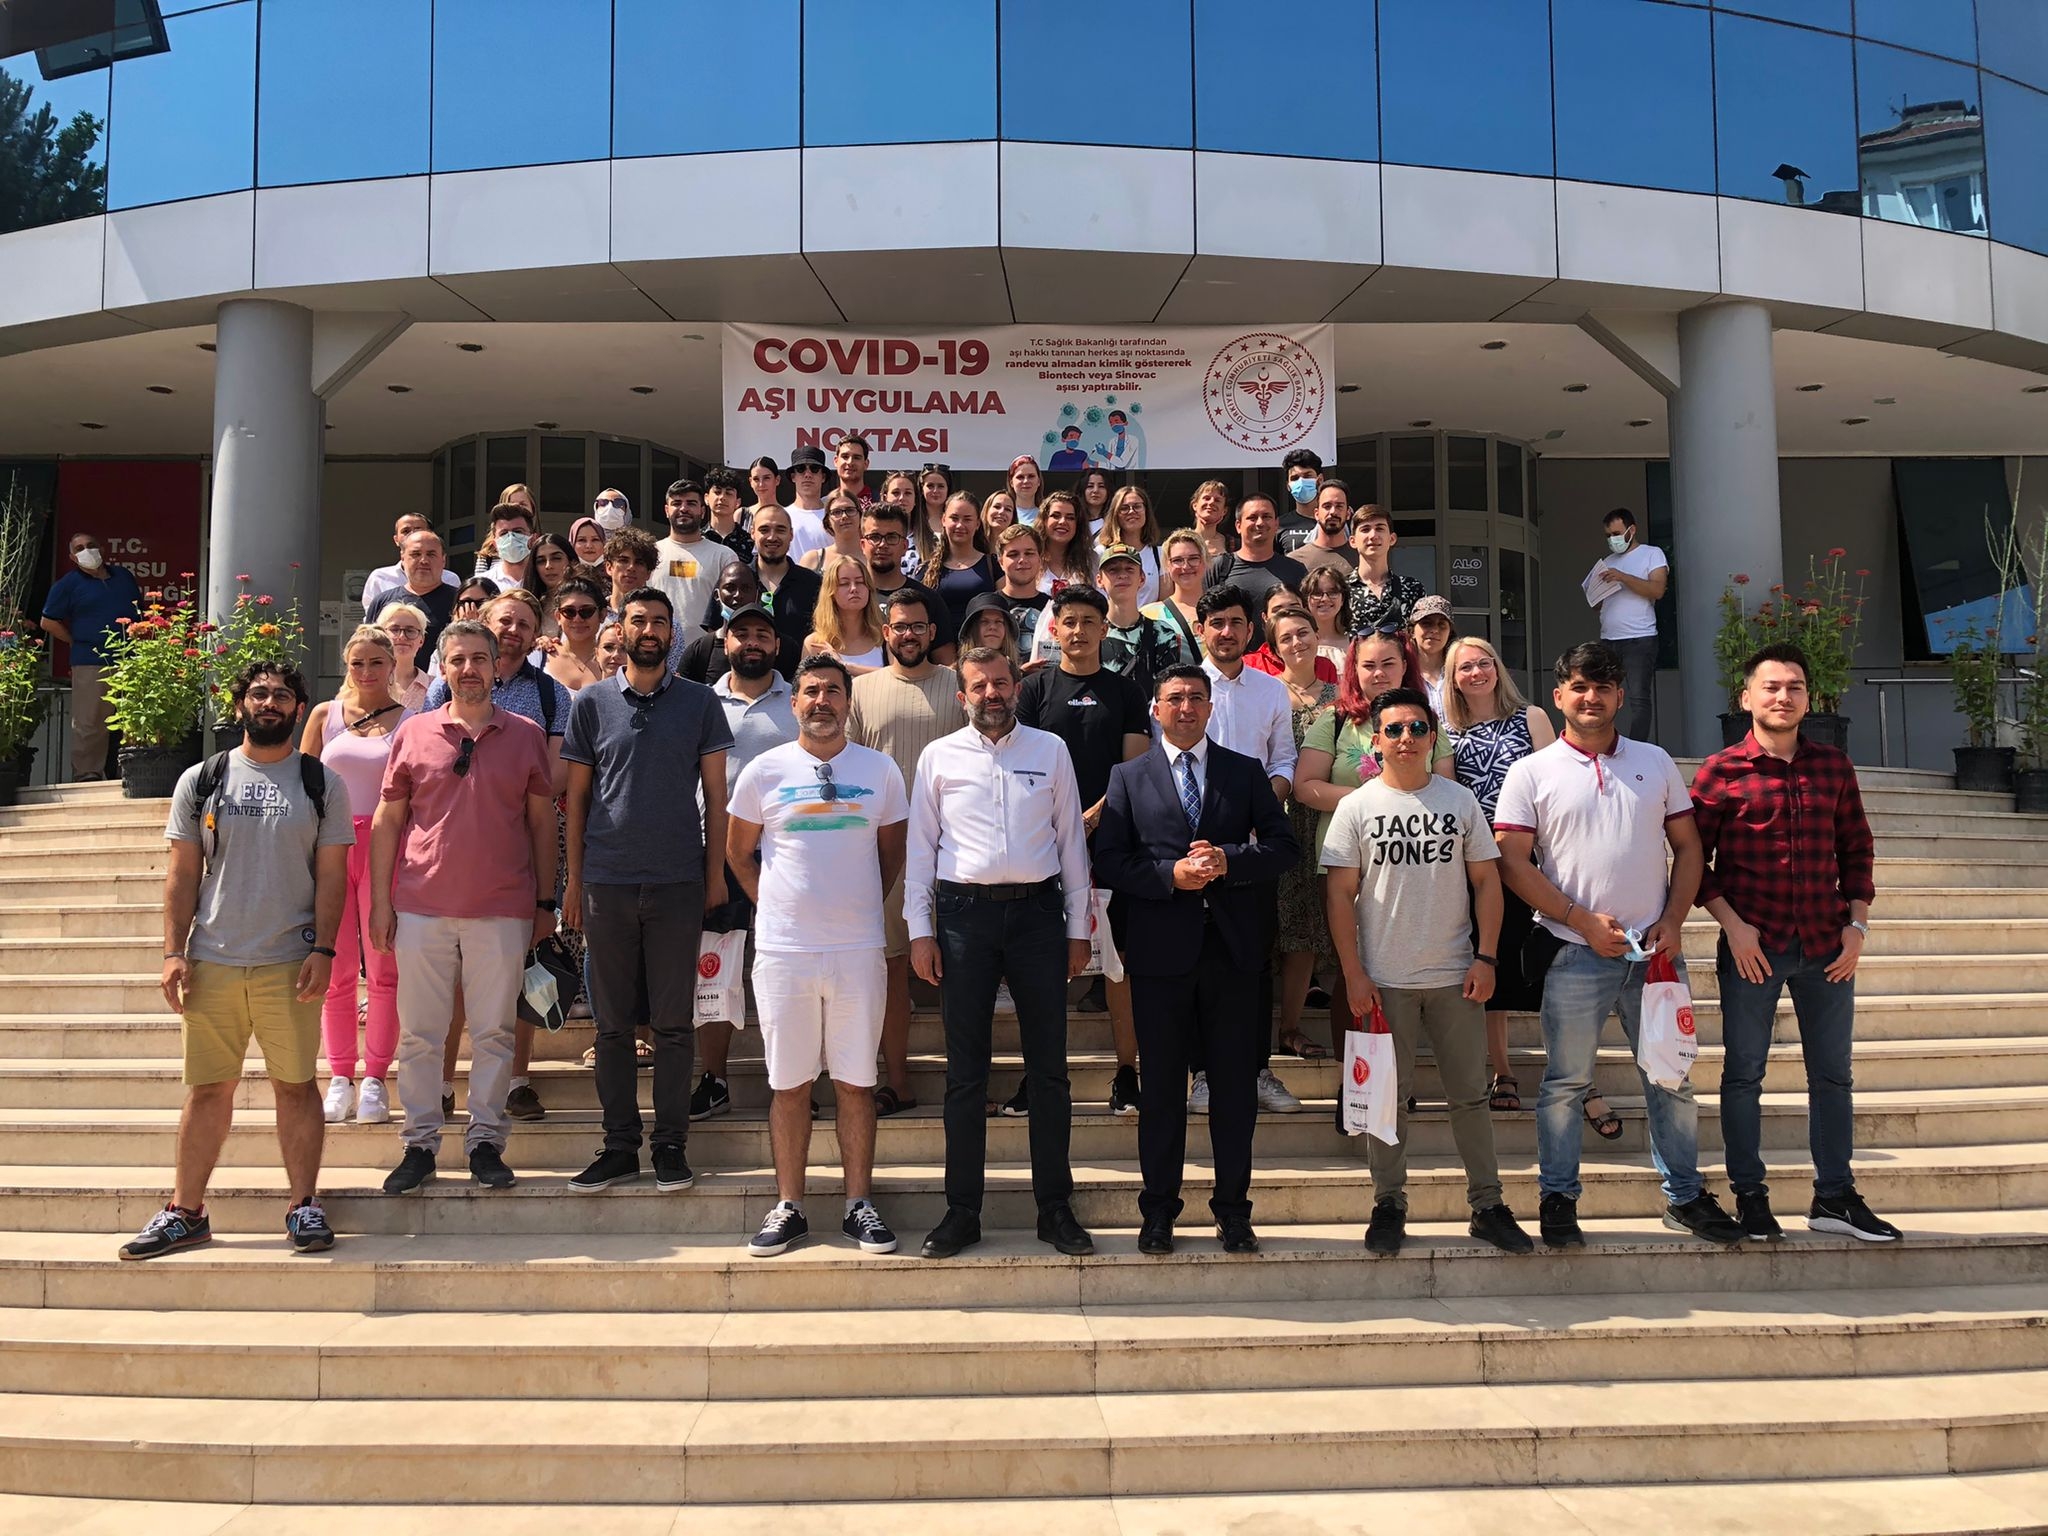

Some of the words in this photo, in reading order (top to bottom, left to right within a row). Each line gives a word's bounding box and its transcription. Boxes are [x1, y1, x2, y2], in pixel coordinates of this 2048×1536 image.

[1045, 338, 1073, 348] Sağlık
[1075, 338, 1118, 348] Bakanlığı
[1120, 338, 1167, 346] tarafından
[753, 338, 990, 375] COVID-19
[1009, 350, 1022, 358] aşı
[1120, 350, 1133, 358] aşı
[1135, 348, 1186, 356] noktasında
[1005, 360, 1048, 368] randevu
[1051, 359, 1096, 368] almadan
[1099, 359, 1132, 367] kimlik
[1135, 359, 1192, 369] göstererek
[1273, 356, 1298, 380] SAĞLIK
[1039, 371, 1085, 379] Biontech
[1088, 373, 1113, 381] veya
[1115, 370, 1156, 379] Sinovac
[1056, 384, 1079, 393] aşısı
[1082, 383, 1142, 393] yaptırabilir.
[737, 387, 796, 419] AŞI
[806, 388, 1006, 415] UYGULAMA
[107, 538, 148, 553] T.C.
[1452, 559, 1482, 569] ALO
[1450, 575, 1478, 586] 153
[241, 782, 279, 801] EGE
[1370, 813, 1459, 838] JACK&
[1373, 838, 1454, 865] JONES
